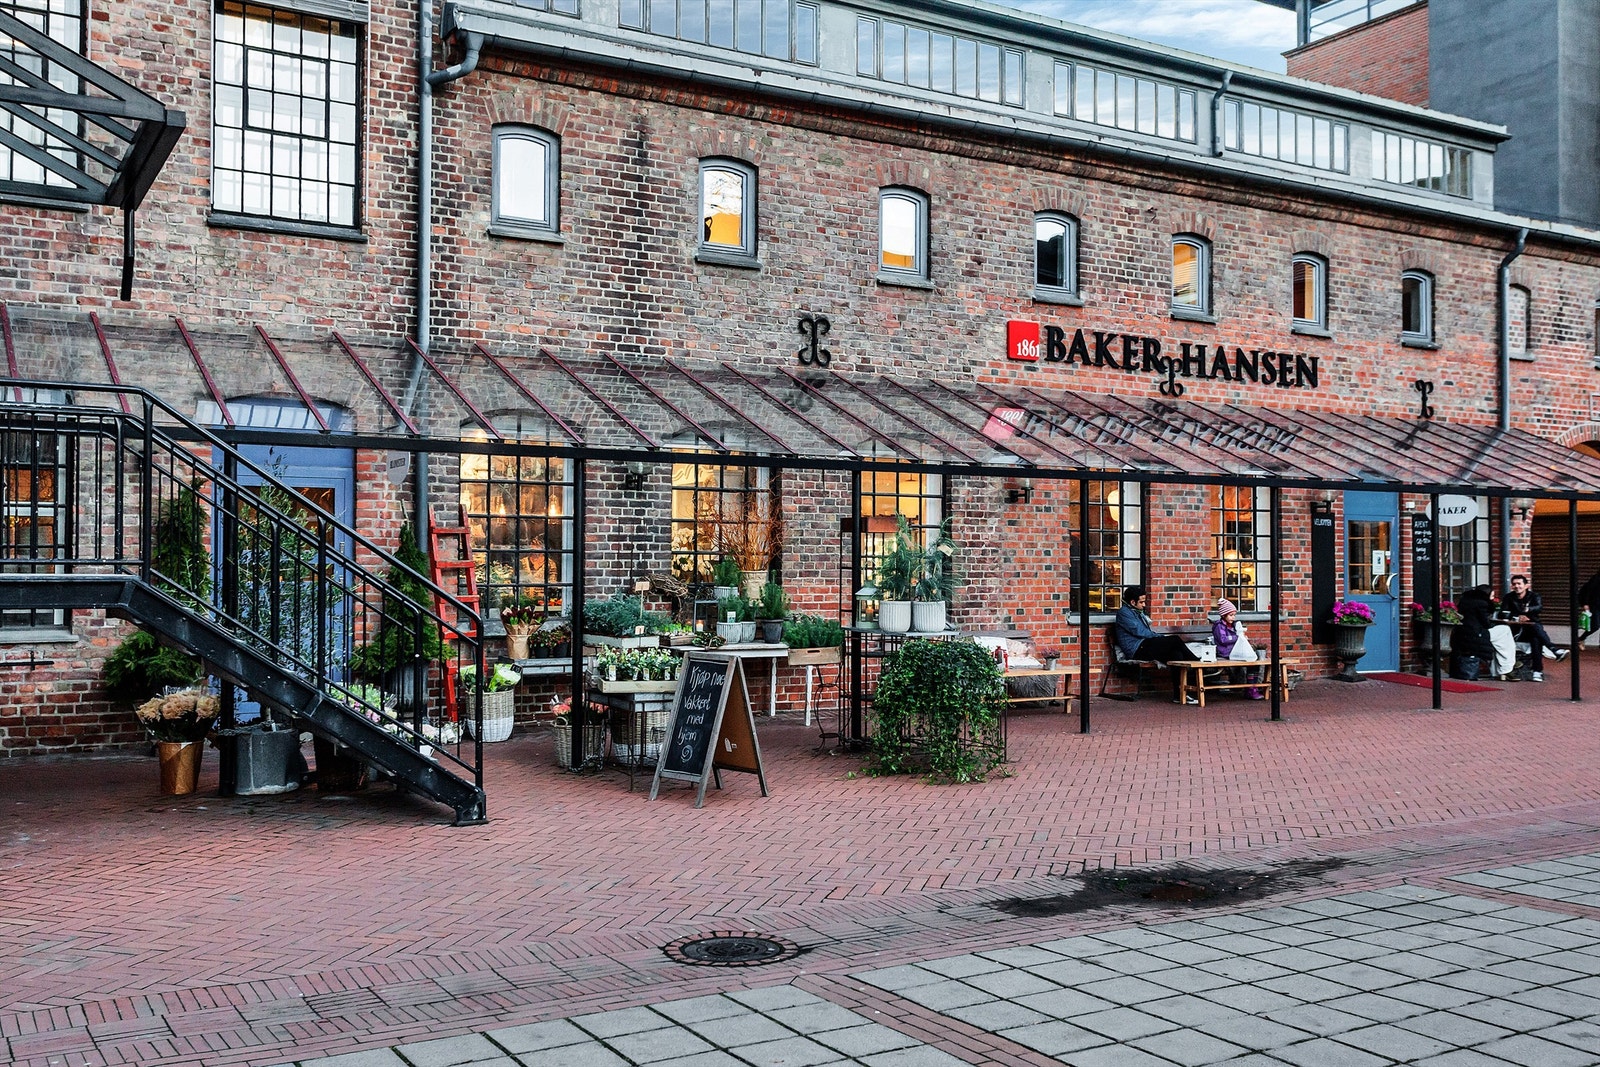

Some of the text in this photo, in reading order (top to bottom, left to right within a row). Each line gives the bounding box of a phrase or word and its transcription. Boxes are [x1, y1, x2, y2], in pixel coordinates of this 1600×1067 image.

[1016, 325, 1319, 388] 1861 BAKER HANSEN
[689, 666, 711, 692] Kjøp
[686, 713, 704, 725] med
[677, 727, 697, 745] hjem
